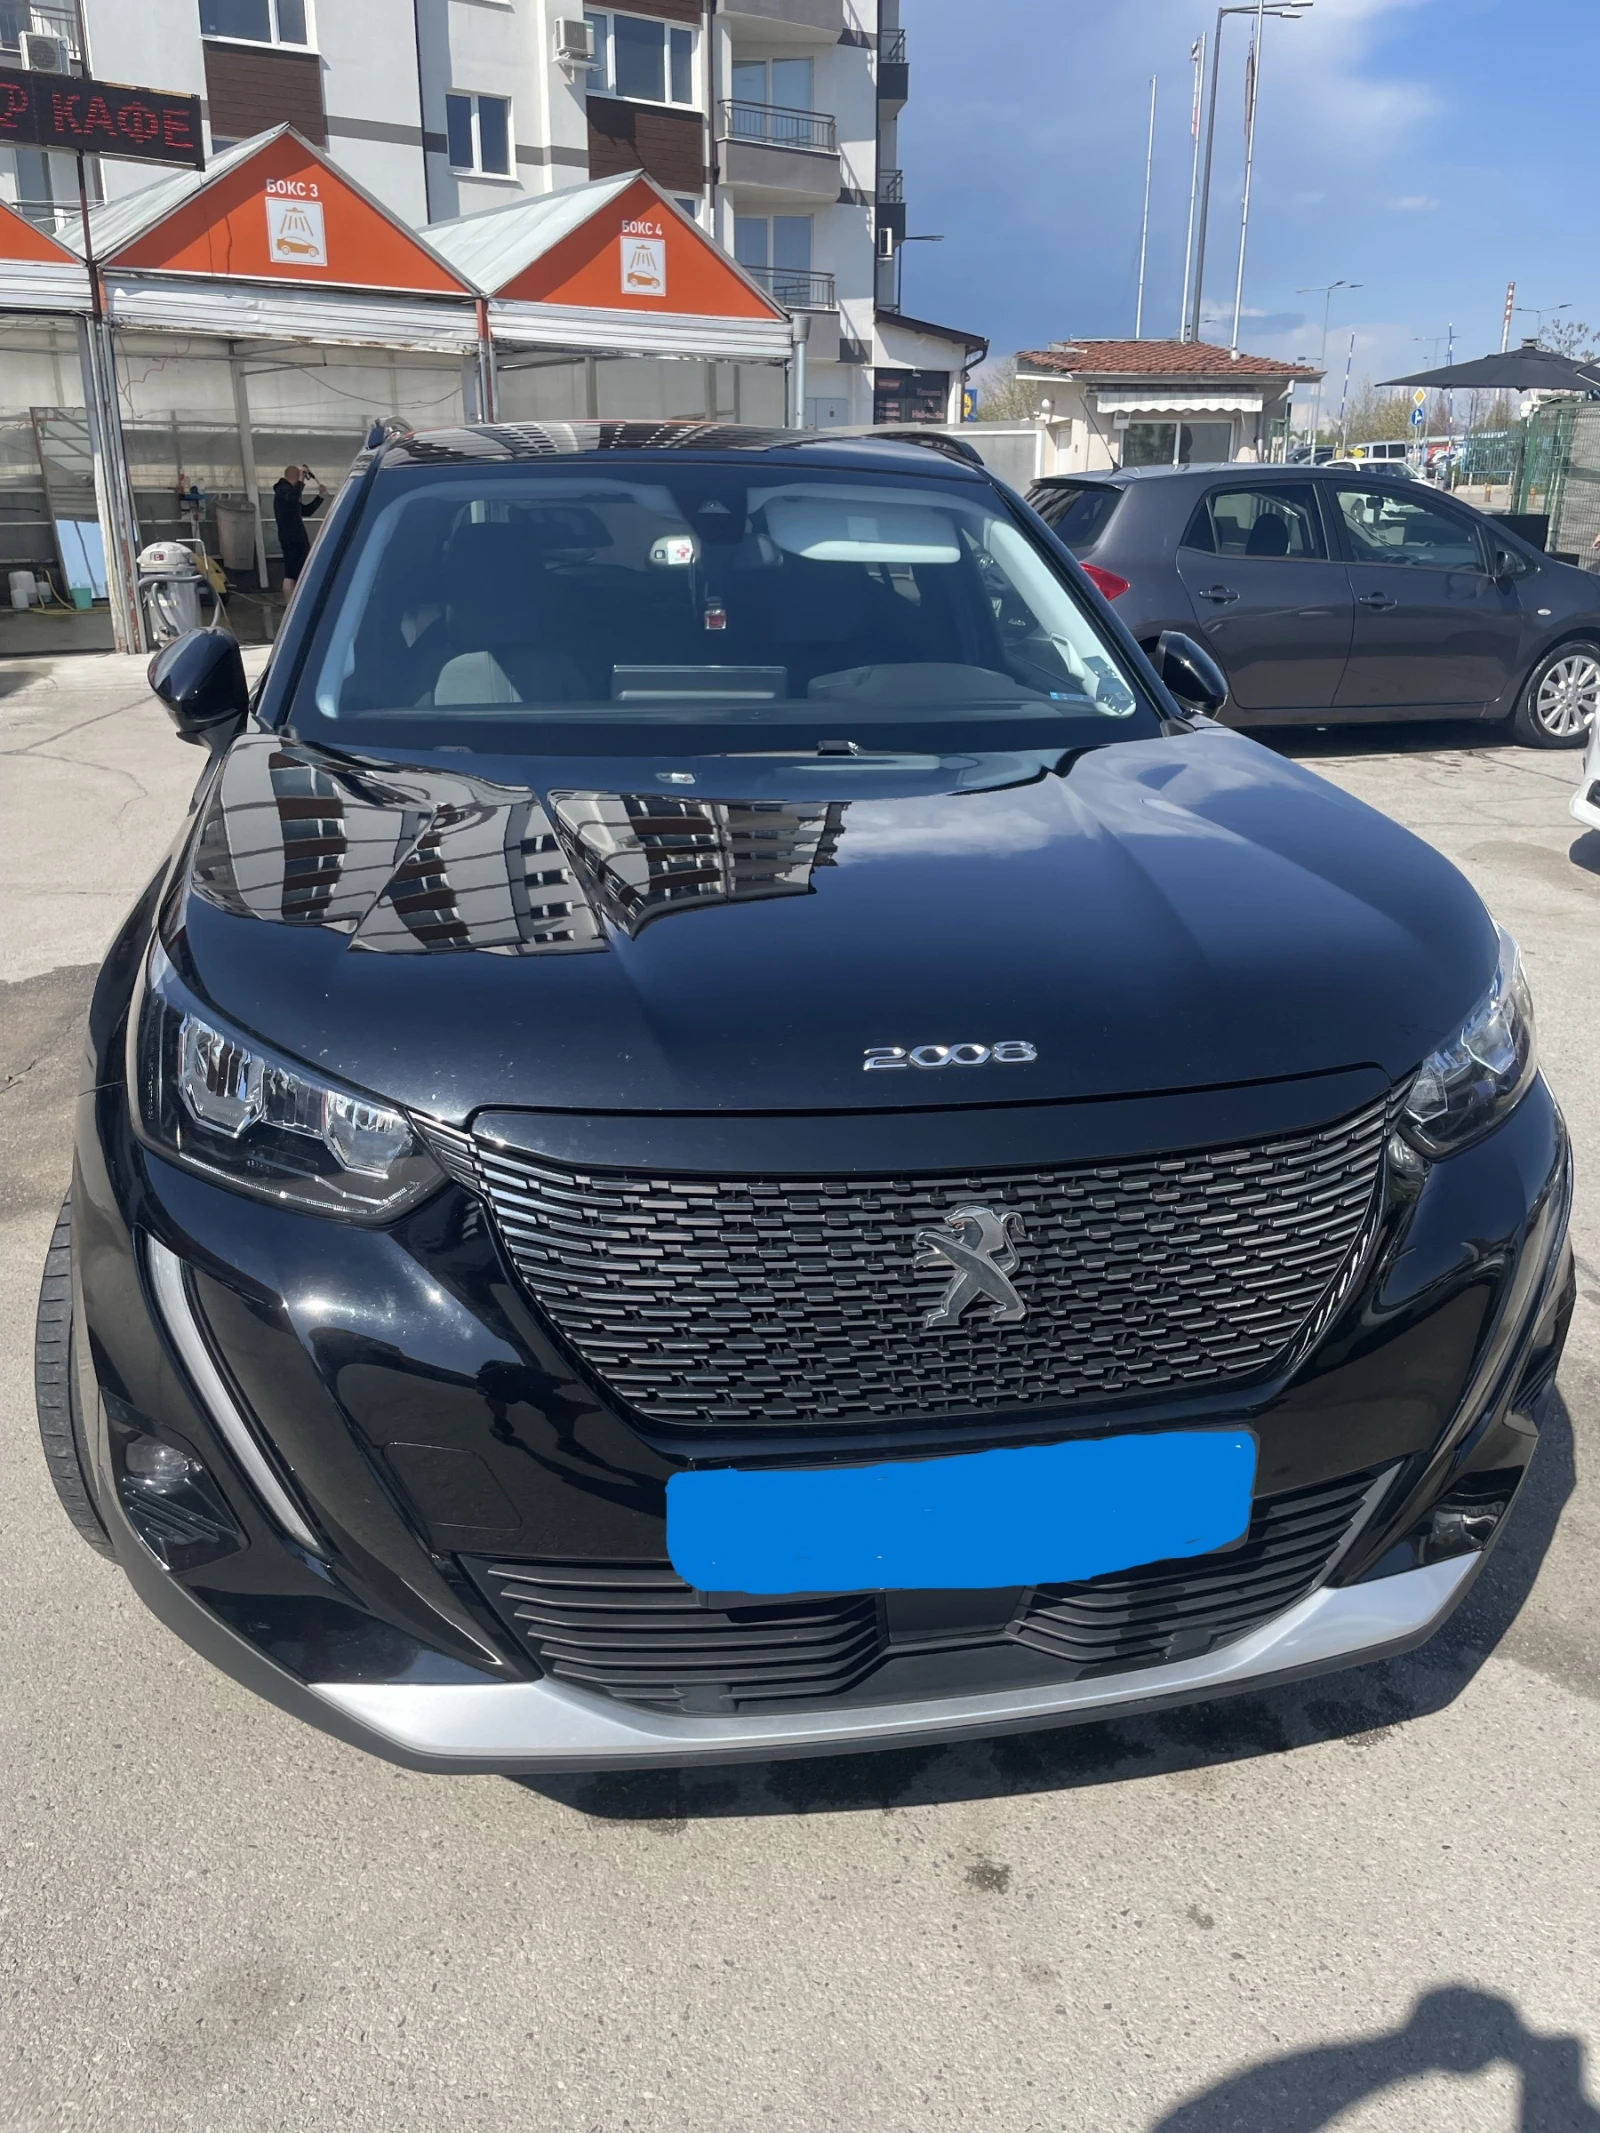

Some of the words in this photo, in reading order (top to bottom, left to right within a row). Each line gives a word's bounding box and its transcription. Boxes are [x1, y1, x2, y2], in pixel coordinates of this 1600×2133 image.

[52, 92, 194, 148] КАФЕ
[266, 178, 307, 196] БОКС
[309, 183, 319, 198] 3
[621, 219, 653, 235] БОКС
[655, 223, 663, 236] 4
[863, 1040, 1038, 1071] 2008
